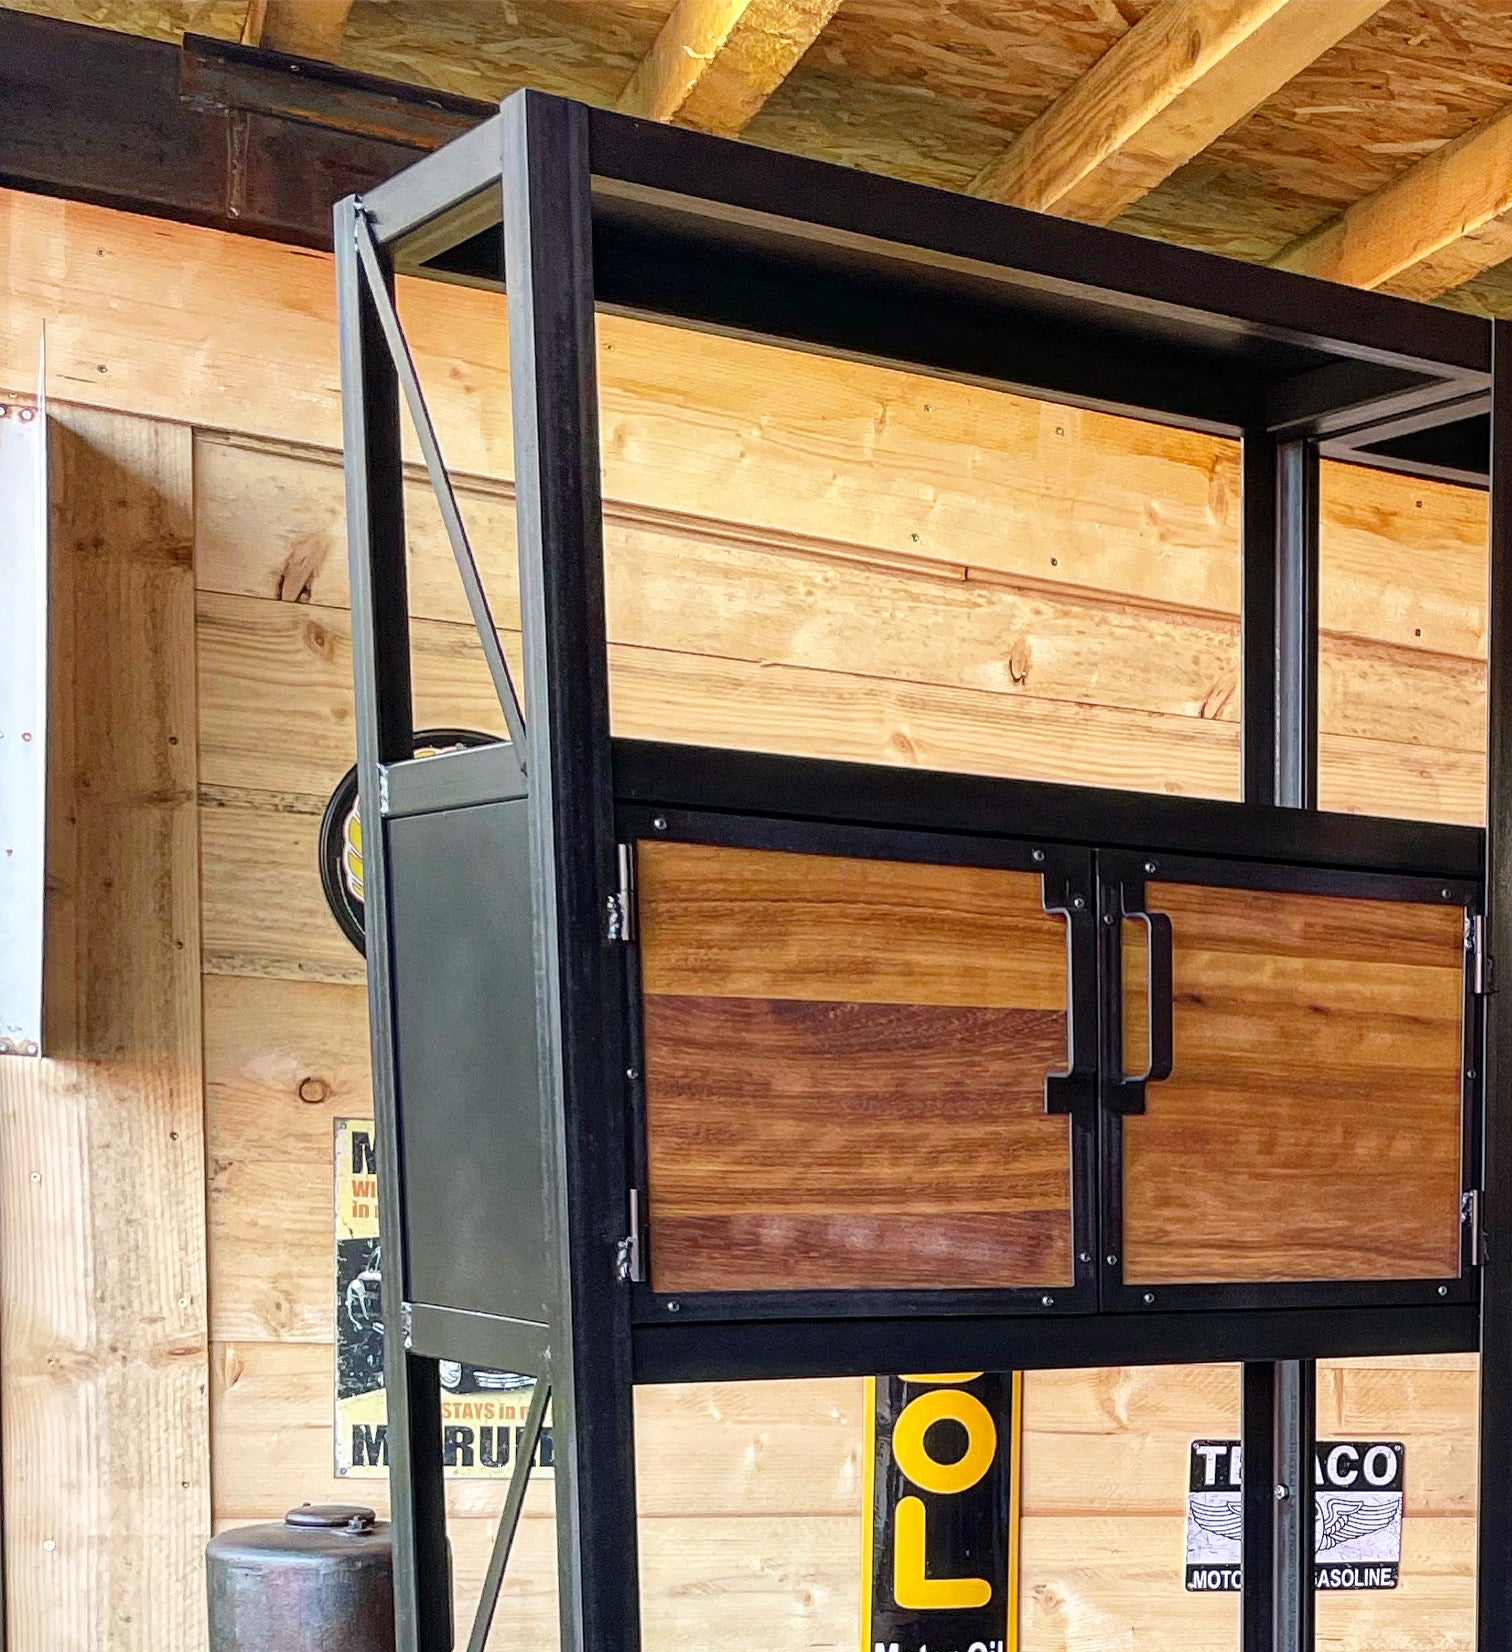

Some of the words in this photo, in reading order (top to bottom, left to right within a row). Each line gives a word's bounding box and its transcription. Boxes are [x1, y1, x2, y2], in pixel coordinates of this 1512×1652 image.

[442, 1402, 495, 1420] STAYS
[499, 1402, 516, 1420] in
[1193, 1569, 1242, 1590] MOTO
[1314, 1567, 1392, 1588] ASOLINE
